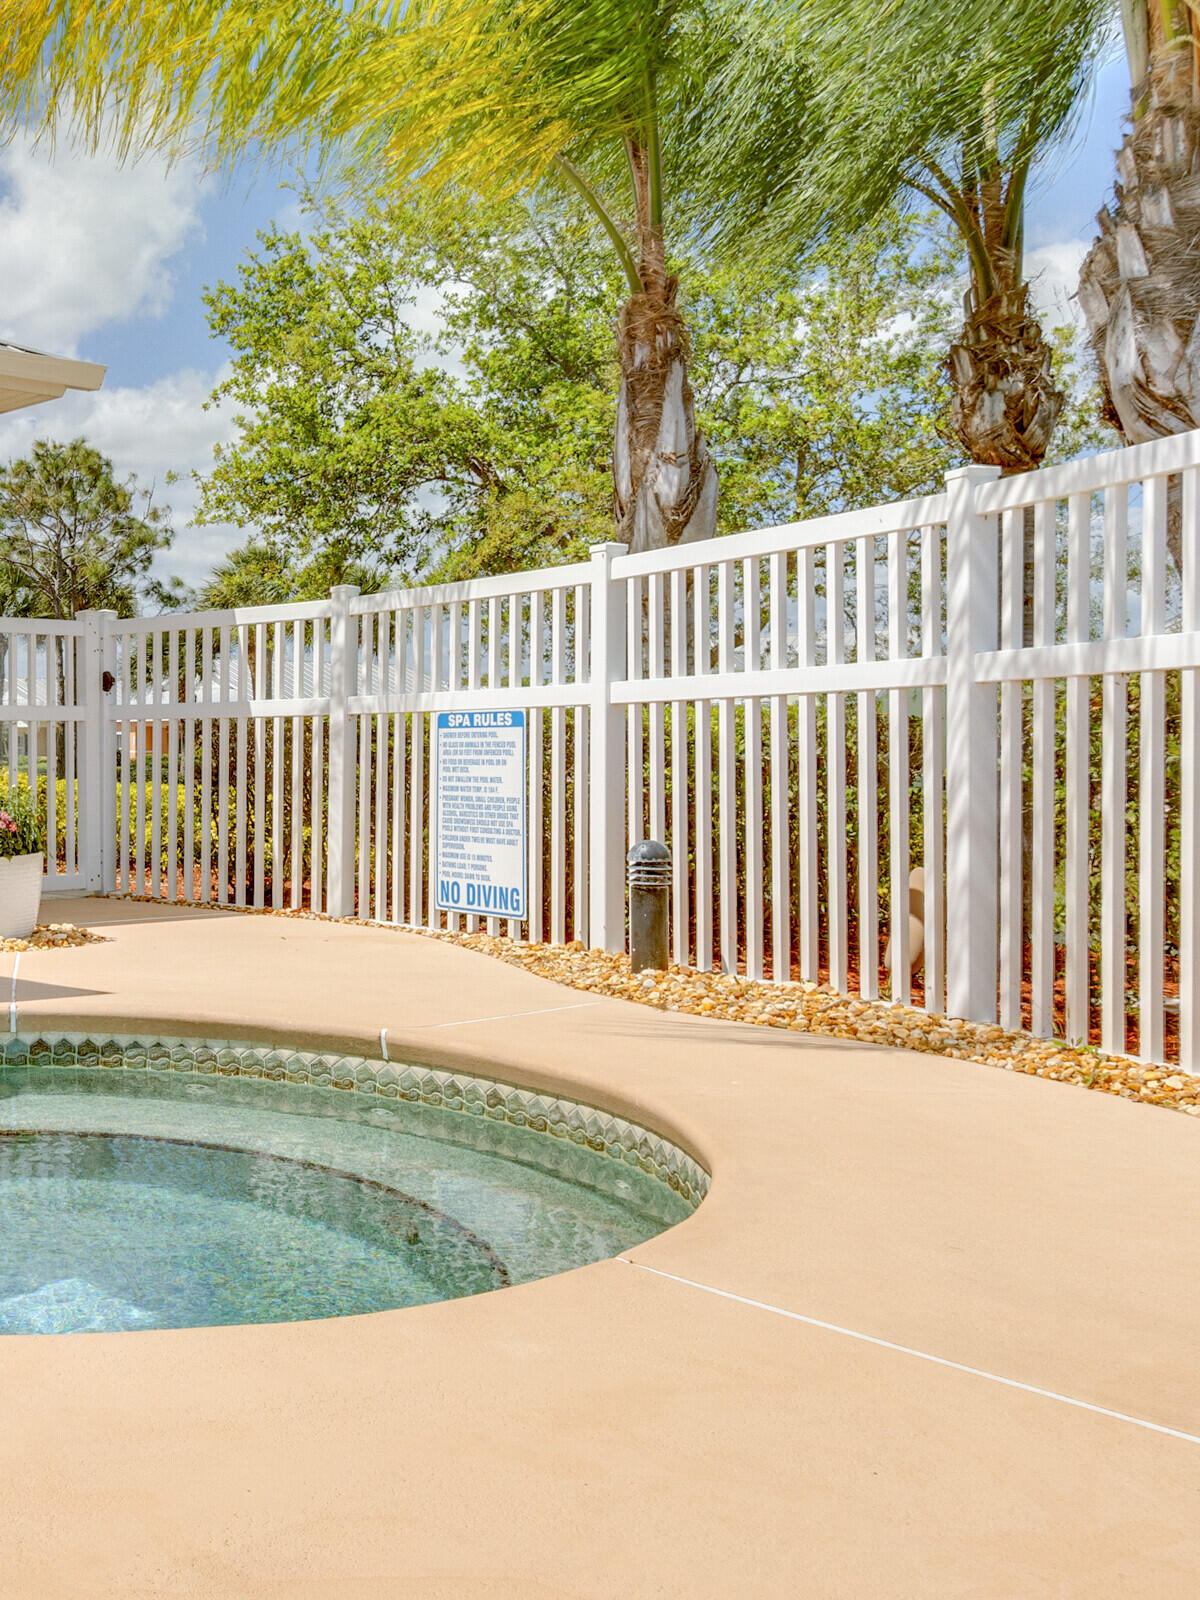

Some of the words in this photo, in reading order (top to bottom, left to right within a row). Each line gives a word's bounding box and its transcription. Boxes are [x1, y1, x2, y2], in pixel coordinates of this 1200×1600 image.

[448, 714, 470, 726] SPA
[474, 712, 512, 726] RULES
[440, 880, 460, 904] NO
[466, 883, 520, 912] DIVING
